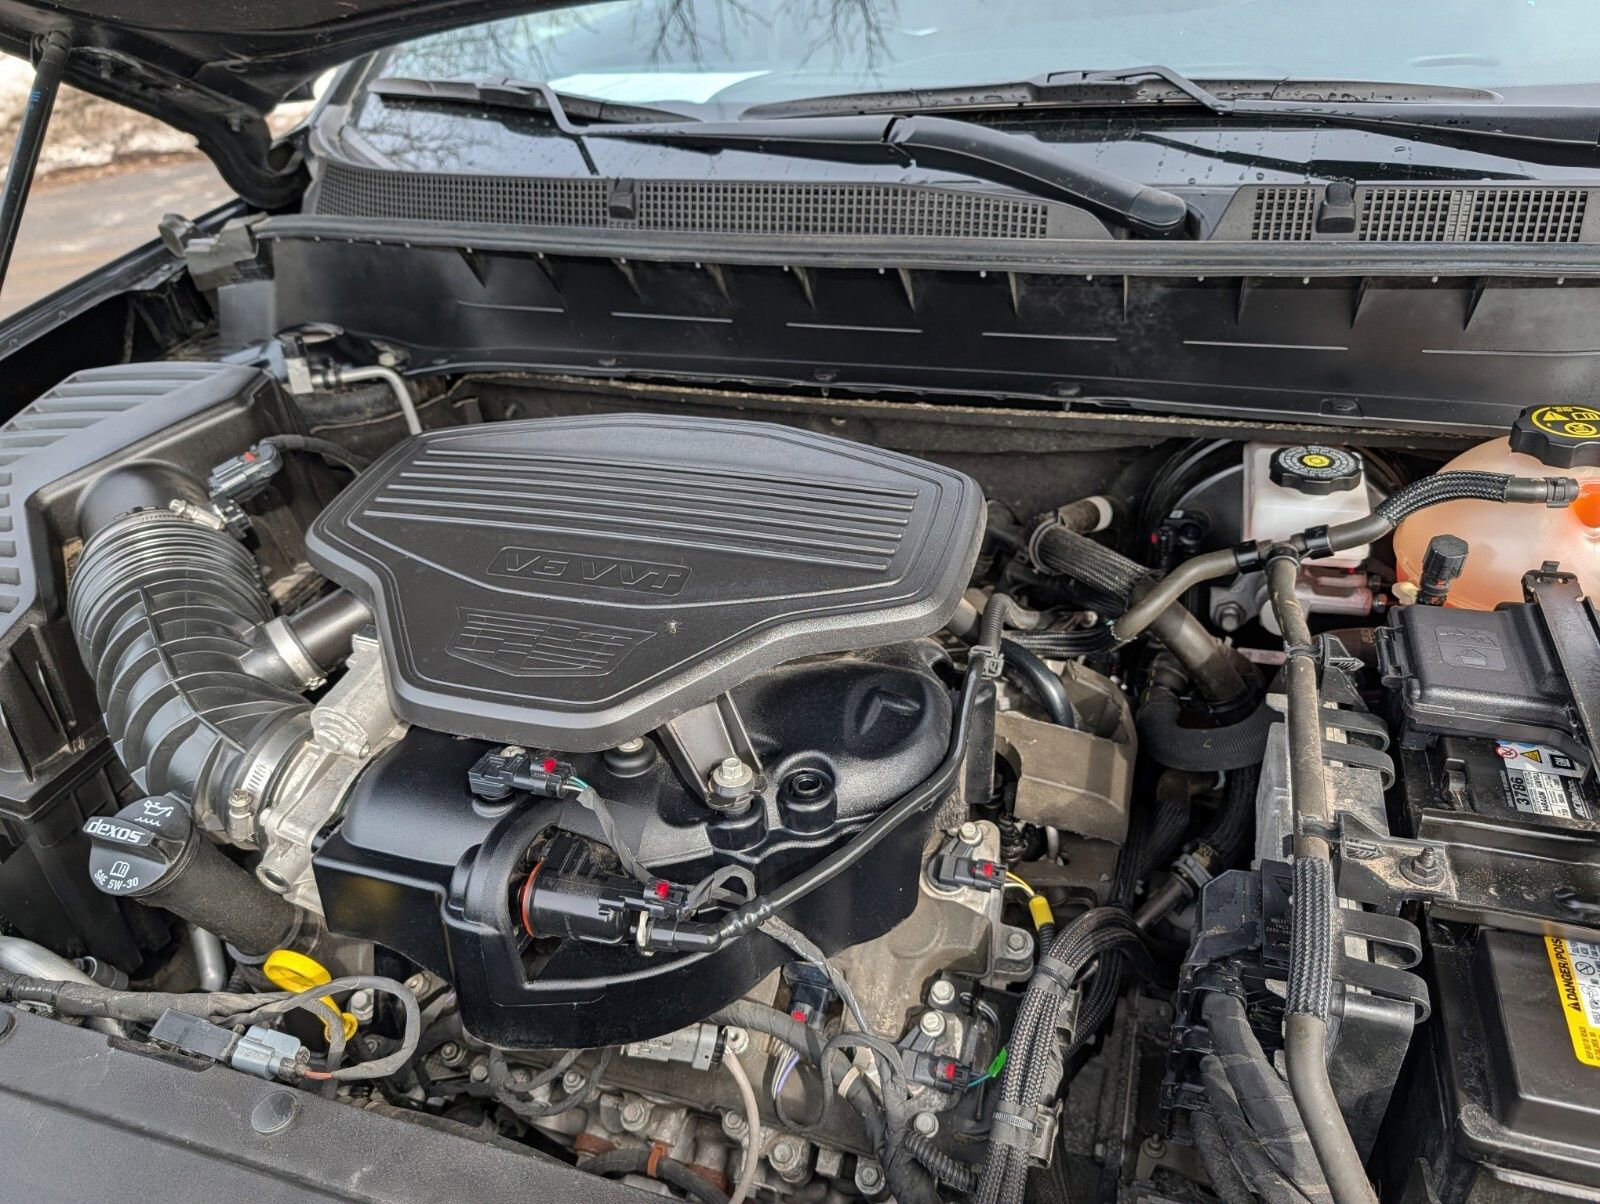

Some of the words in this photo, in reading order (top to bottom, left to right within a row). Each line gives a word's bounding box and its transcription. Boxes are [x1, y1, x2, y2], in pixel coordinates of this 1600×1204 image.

[506, 552, 570, 577] V6
[581, 560, 682, 588] VVT
[1510, 777, 1530, 806] 3786
[86, 819, 146, 843] dexos
[94, 869, 108, 886] SAE
[108, 877, 139, 890] 5W-30
[1551, 936, 1579, 1001] DANGER/POIS
